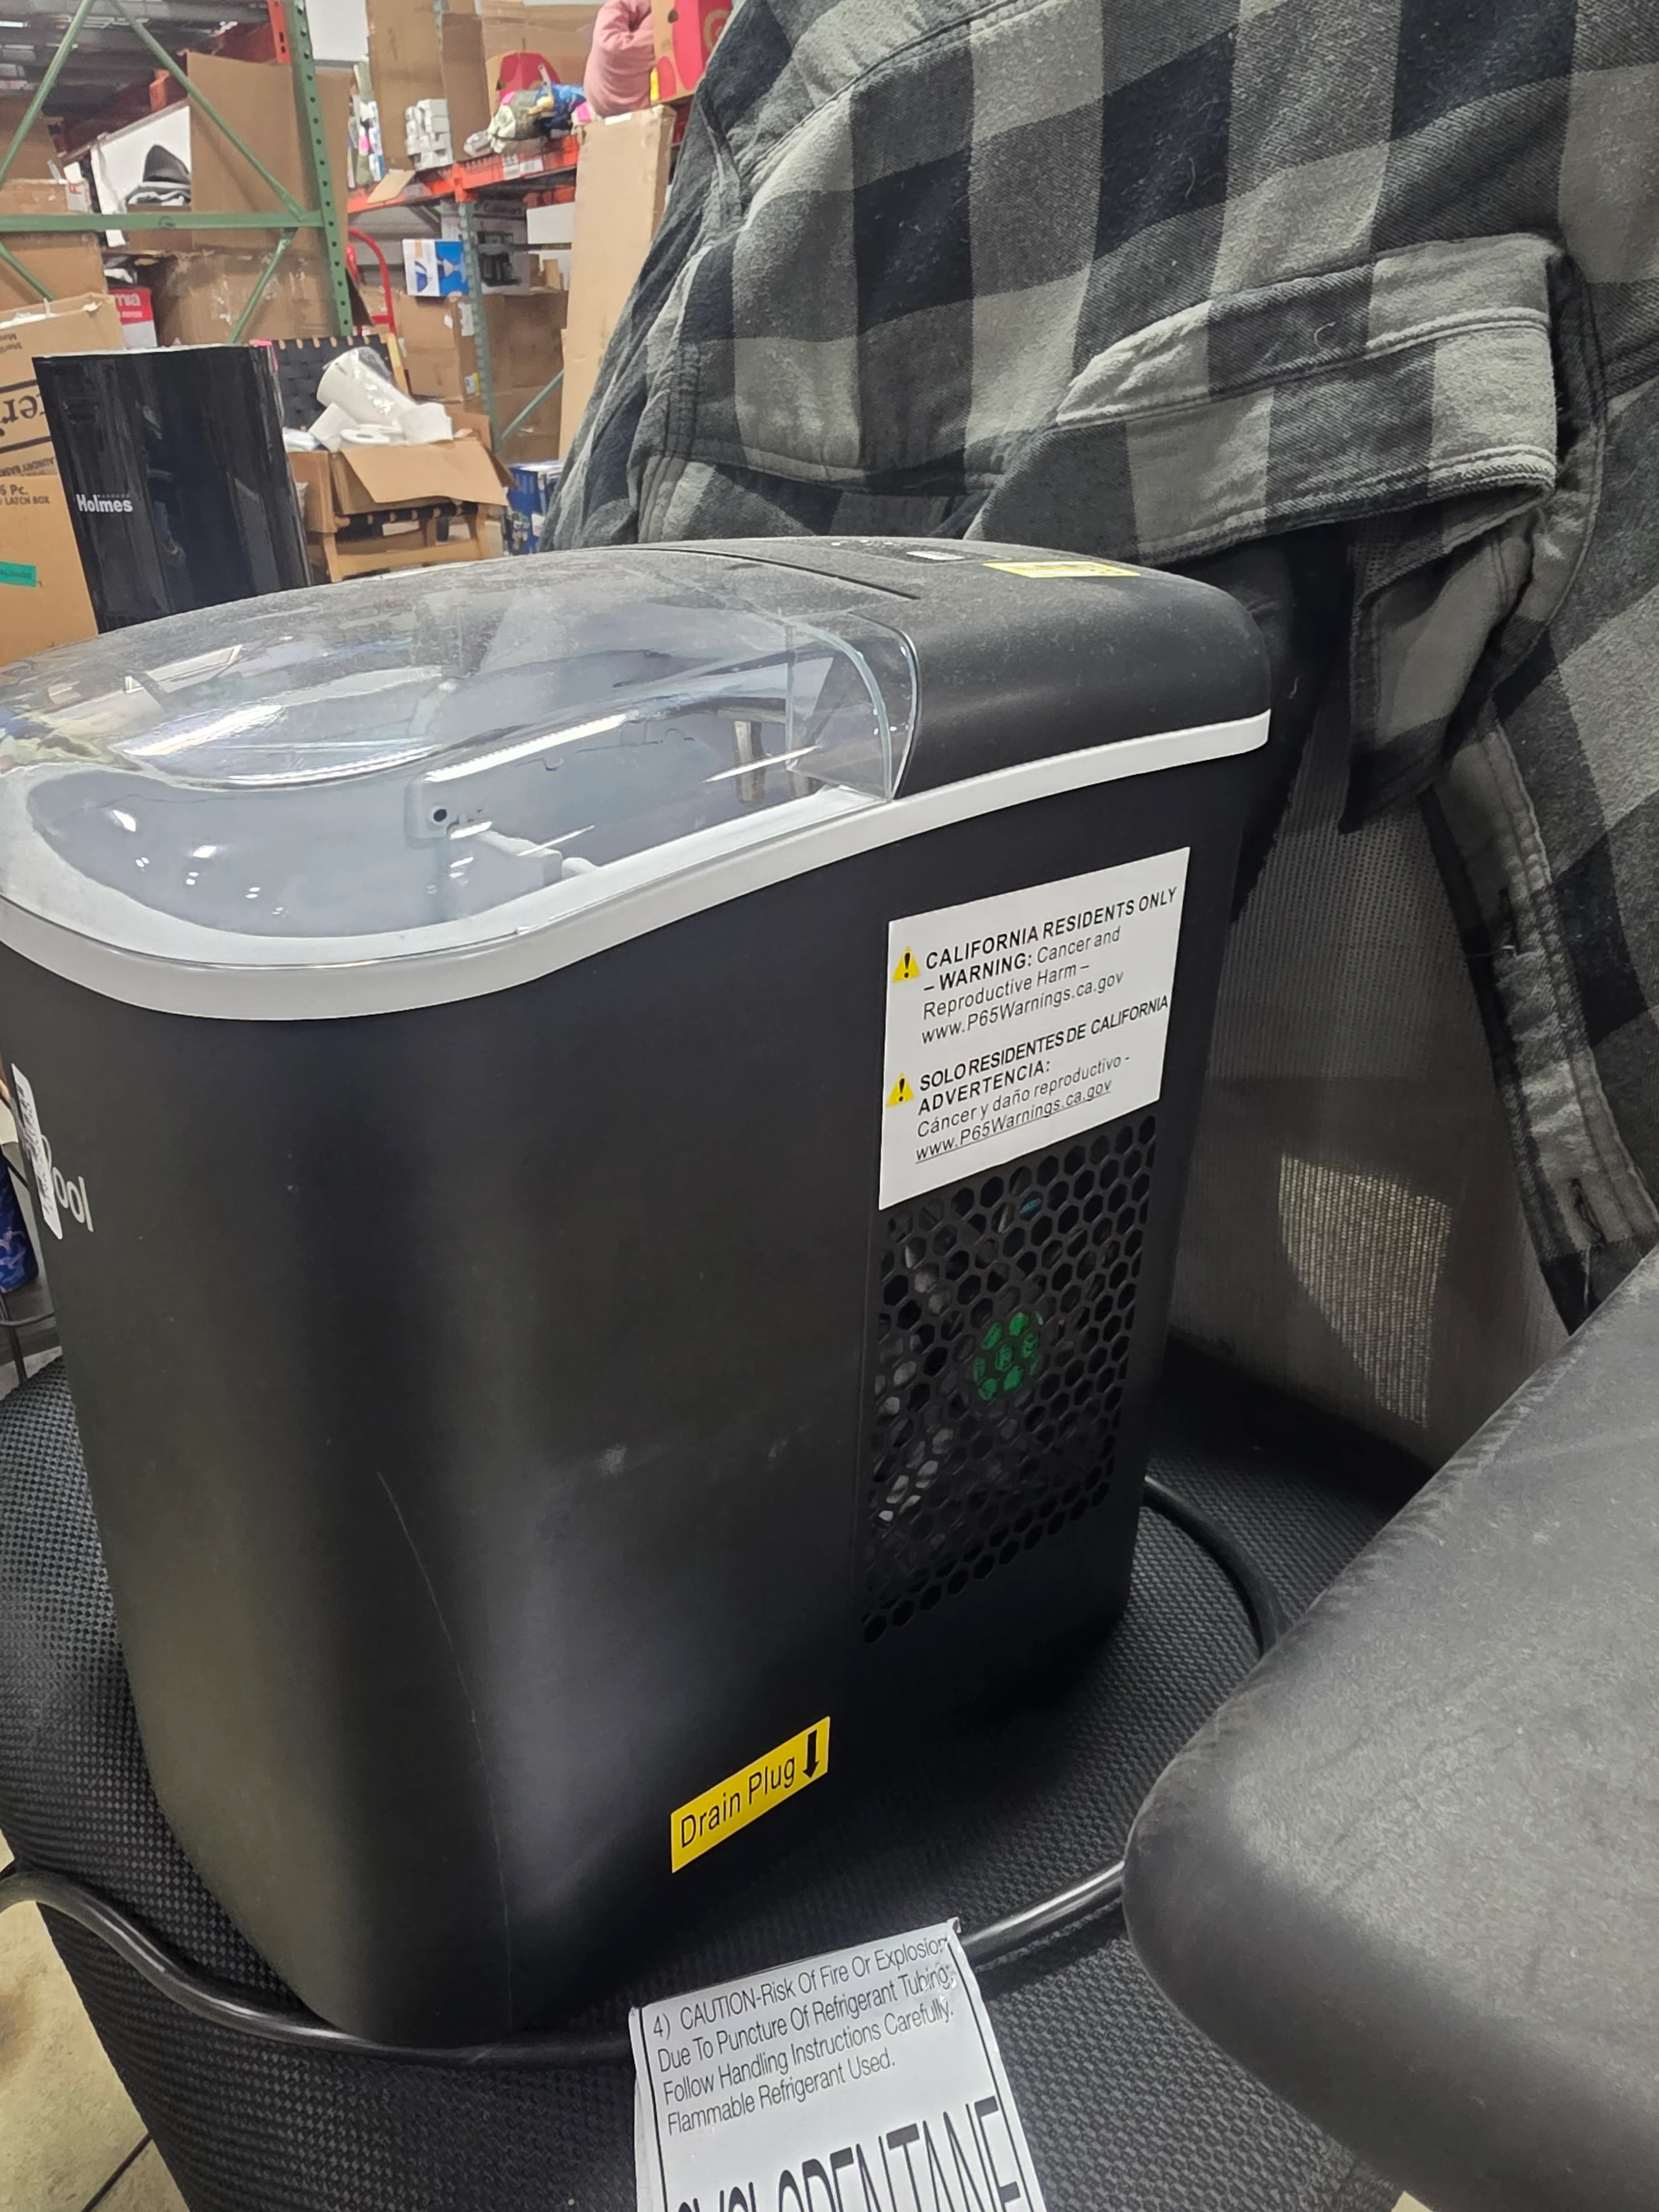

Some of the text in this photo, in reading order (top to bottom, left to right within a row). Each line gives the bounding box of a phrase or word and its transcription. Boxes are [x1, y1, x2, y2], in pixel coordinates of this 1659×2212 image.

[76, 494, 133, 512] Holmes
[926, 886, 1177, 969] CALIFORNIA RESIDENTS ONLY
[940, 953, 1032, 990] WARNING:
[1037, 937, 1091, 963] Cancer
[1094, 925, 1120, 947] and
[922, 972, 1124, 1044] www.P65Warnings.ca.gov
[924, 978, 1032, 1020] Reproductive
[1037, 964, 1076, 987] Harm
[920, 995, 1168, 1091] SOLO RESIDENTES DE CALIFORNIA
[916, 1079, 1112, 1162] www.P65Warnings.ca.gov
[917, 1108, 977, 1138] Cáncer
[980, 1103, 989, 1120] y
[993, 1089, 1030, 1112] daño
[1034, 1056, 1121, 1098] reproductivo
[918, 1060, 1050, 1116] ADVERTENCIA:
[681, 1757, 795, 1848] Drain Plug
[653, 2013, 670, 2041] 4)
[680, 1978, 796, 2030] CAUTION-Risk
[798, 1969, 817, 1994] Of
[820, 1964, 849, 1988] Fire
[852, 1956, 870, 1978] Or
[658, 2047, 691, 2073] Due
[692, 2036, 713, 2060] To
[717, 2018, 787, 2054] Puncture
[790, 2004, 810, 2031] Of
[812, 1980, 898, 2025] Refrigerant
[664, 1999, 954, 2105] Follow Handling Instructions Carefully.
[667, 2047, 895, 2136] Flammable Refrigerant Used.
